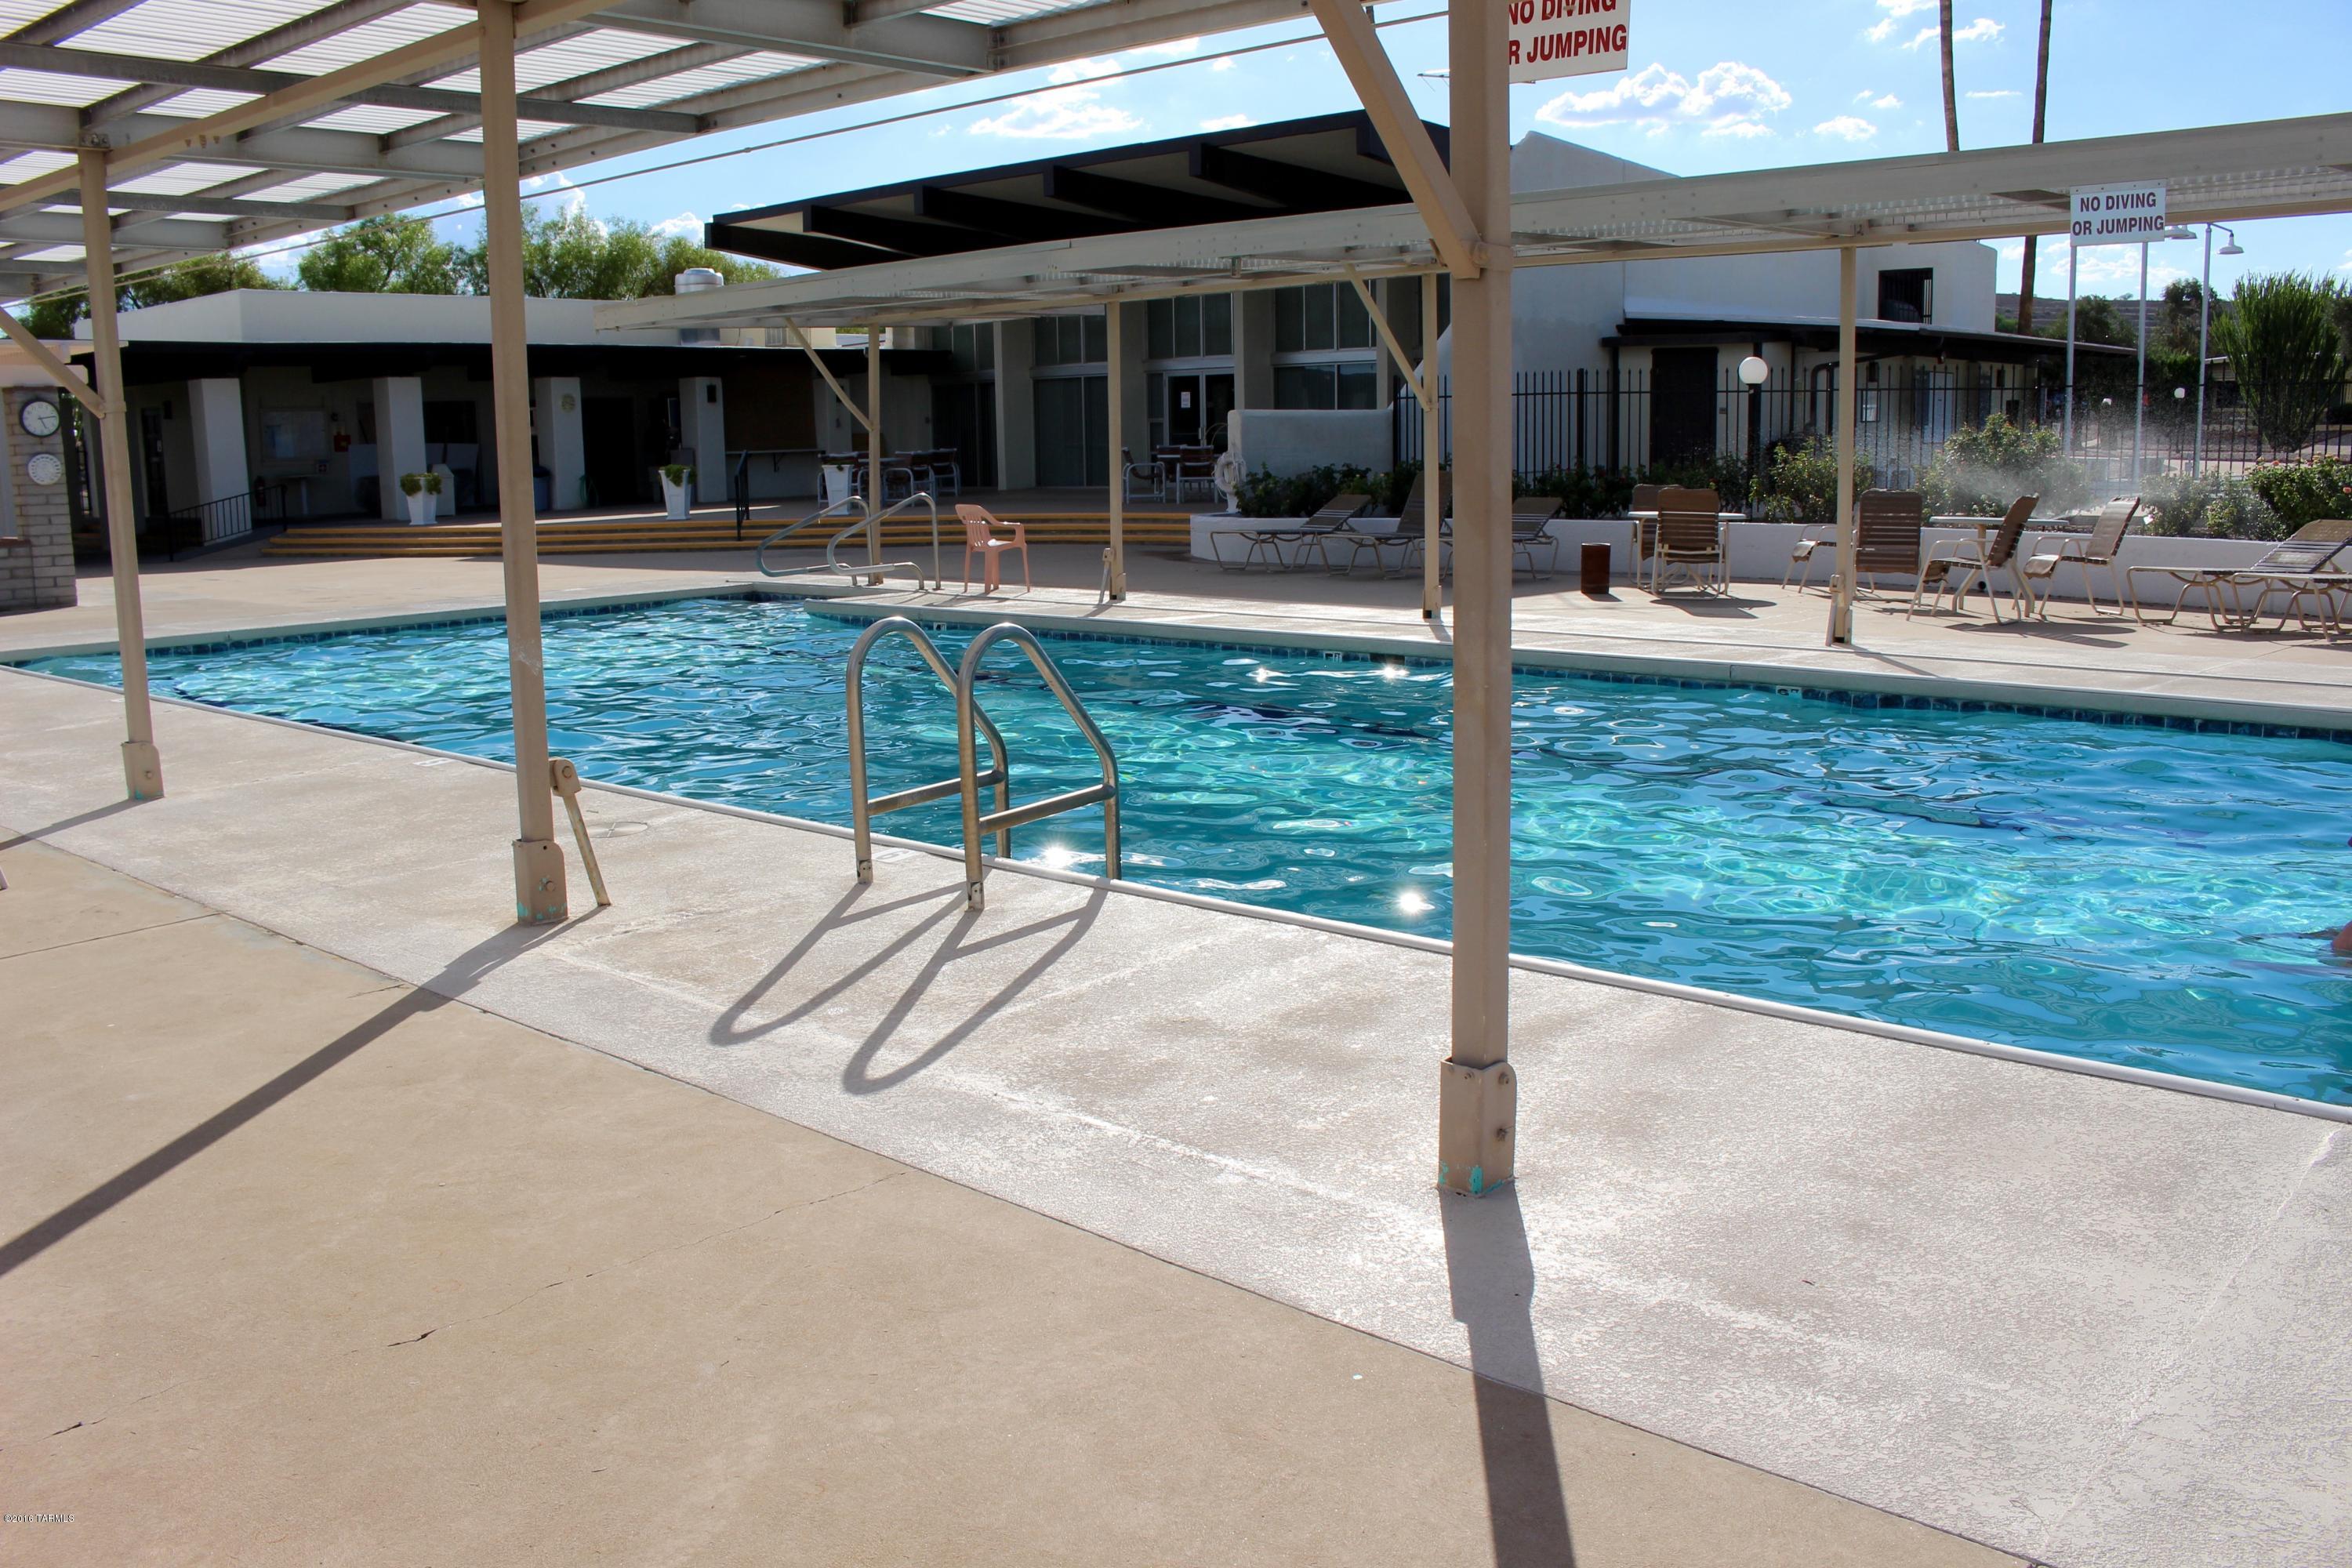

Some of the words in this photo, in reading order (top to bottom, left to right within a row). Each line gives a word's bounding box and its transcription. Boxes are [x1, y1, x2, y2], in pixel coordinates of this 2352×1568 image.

[1509, 1, 1534, 25] NO
[1509, 40, 1520, 65] R
[1527, 24, 1627, 64] JUMPING
[2080, 196, 2100, 212] NO
[2106, 192, 2156, 210] DIVING
[2072, 220, 2092, 236] OR
[2096, 215, 2164, 234] JUMPING
